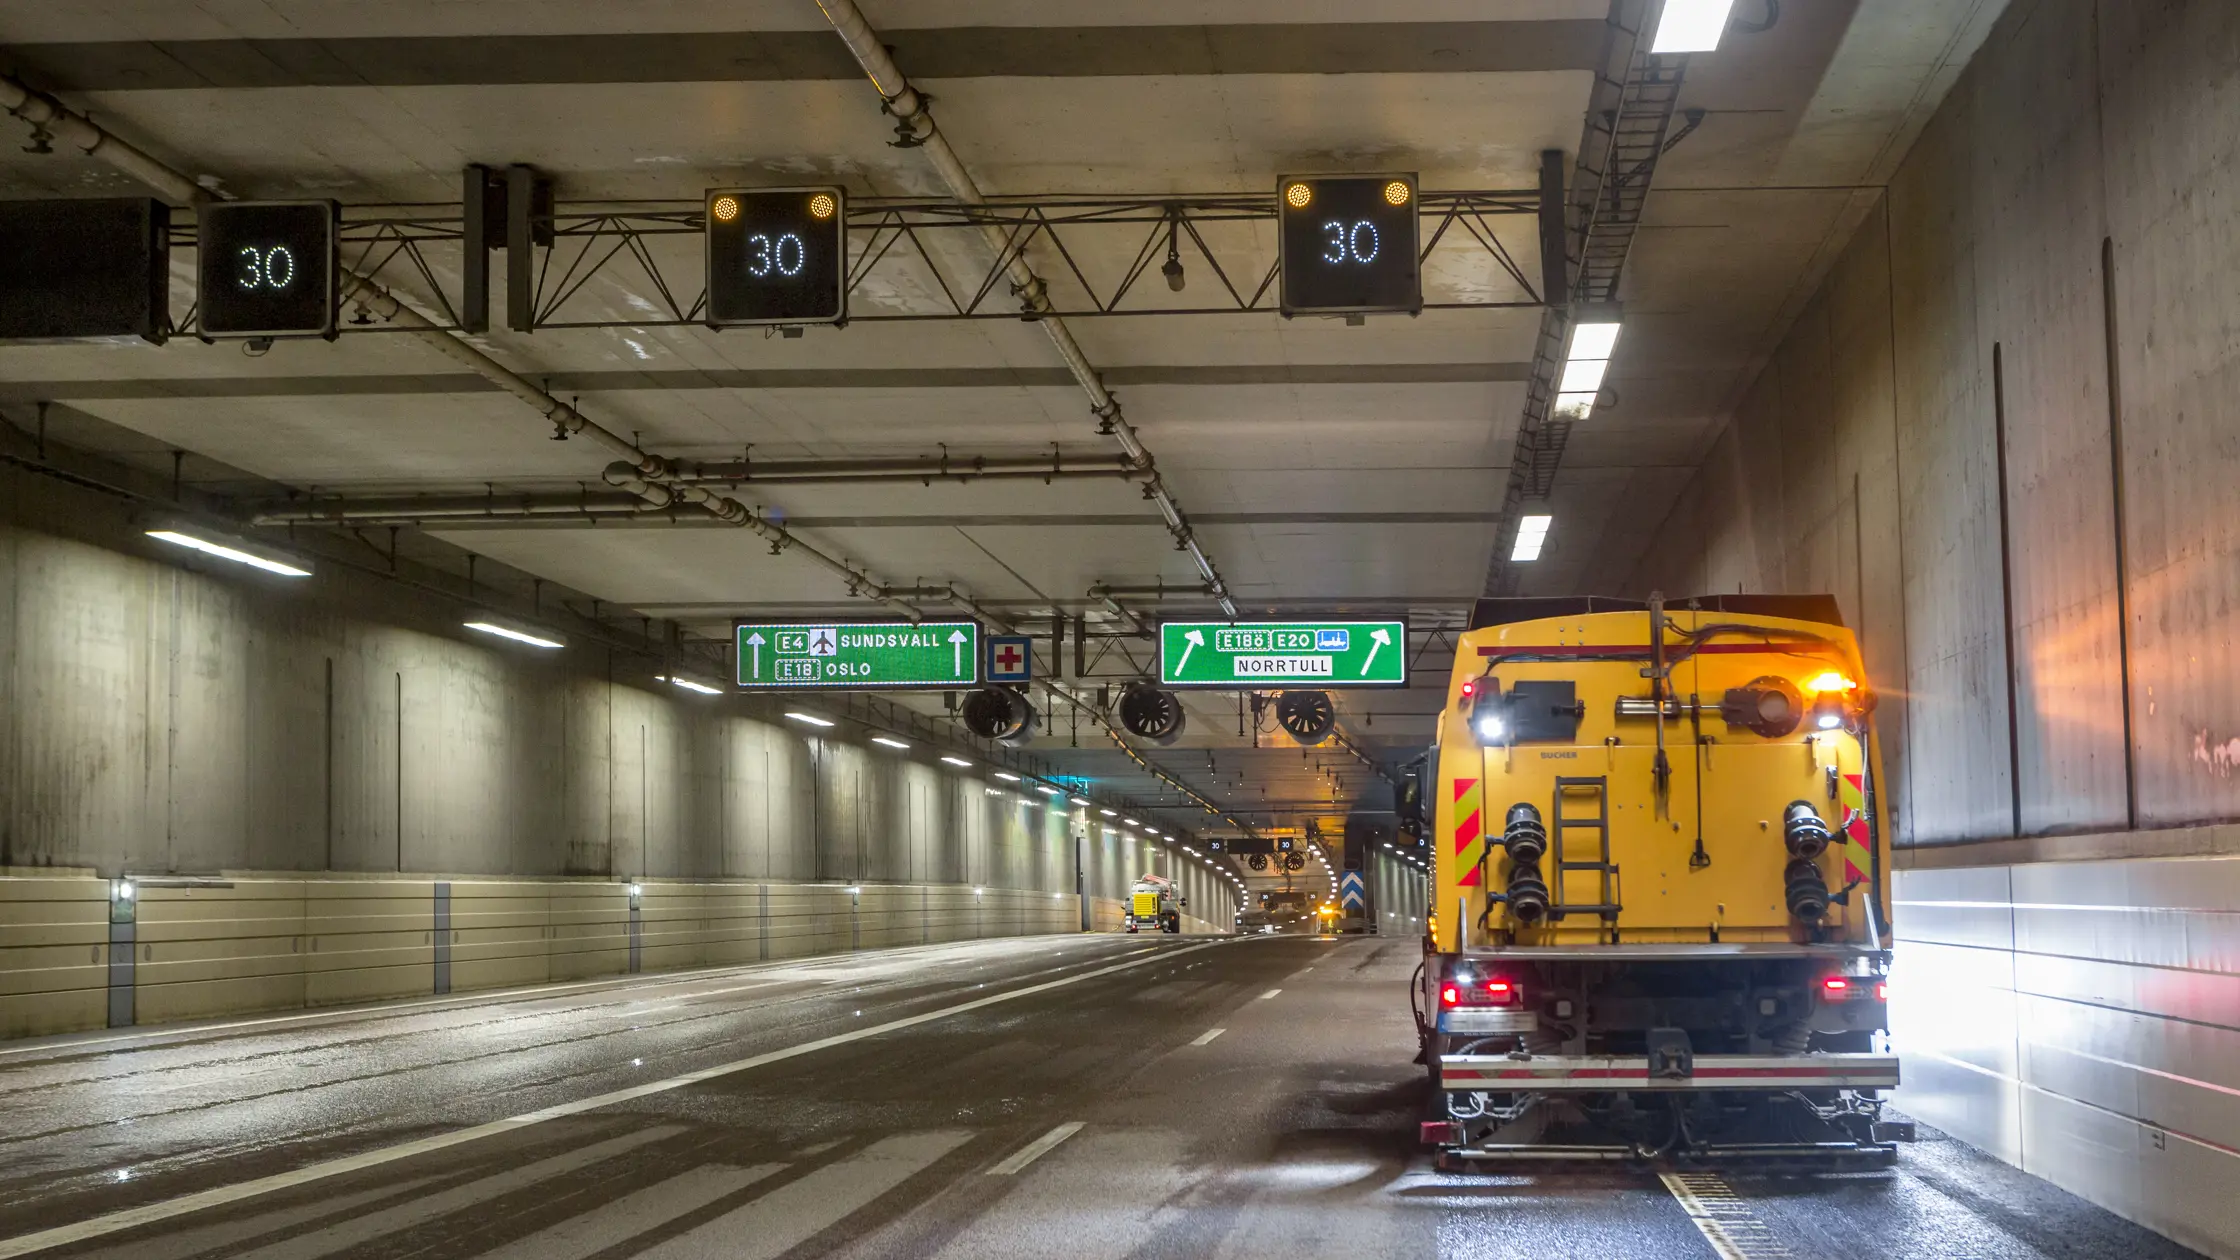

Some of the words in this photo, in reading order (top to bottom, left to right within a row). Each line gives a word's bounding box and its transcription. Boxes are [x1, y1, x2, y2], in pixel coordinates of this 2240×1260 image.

[1324, 221, 1379, 263] 30
[749, 233, 804, 275] 30
[239, 246, 294, 288] 30
[782, 636, 803, 649] E4
[840, 634, 940, 647] SUNDSVALL
[1278, 634, 1310, 647] E20
[784, 663, 812, 676] E18
[826, 663, 871, 675] OSLO
[1238, 659, 1328, 672] NORRTULL
